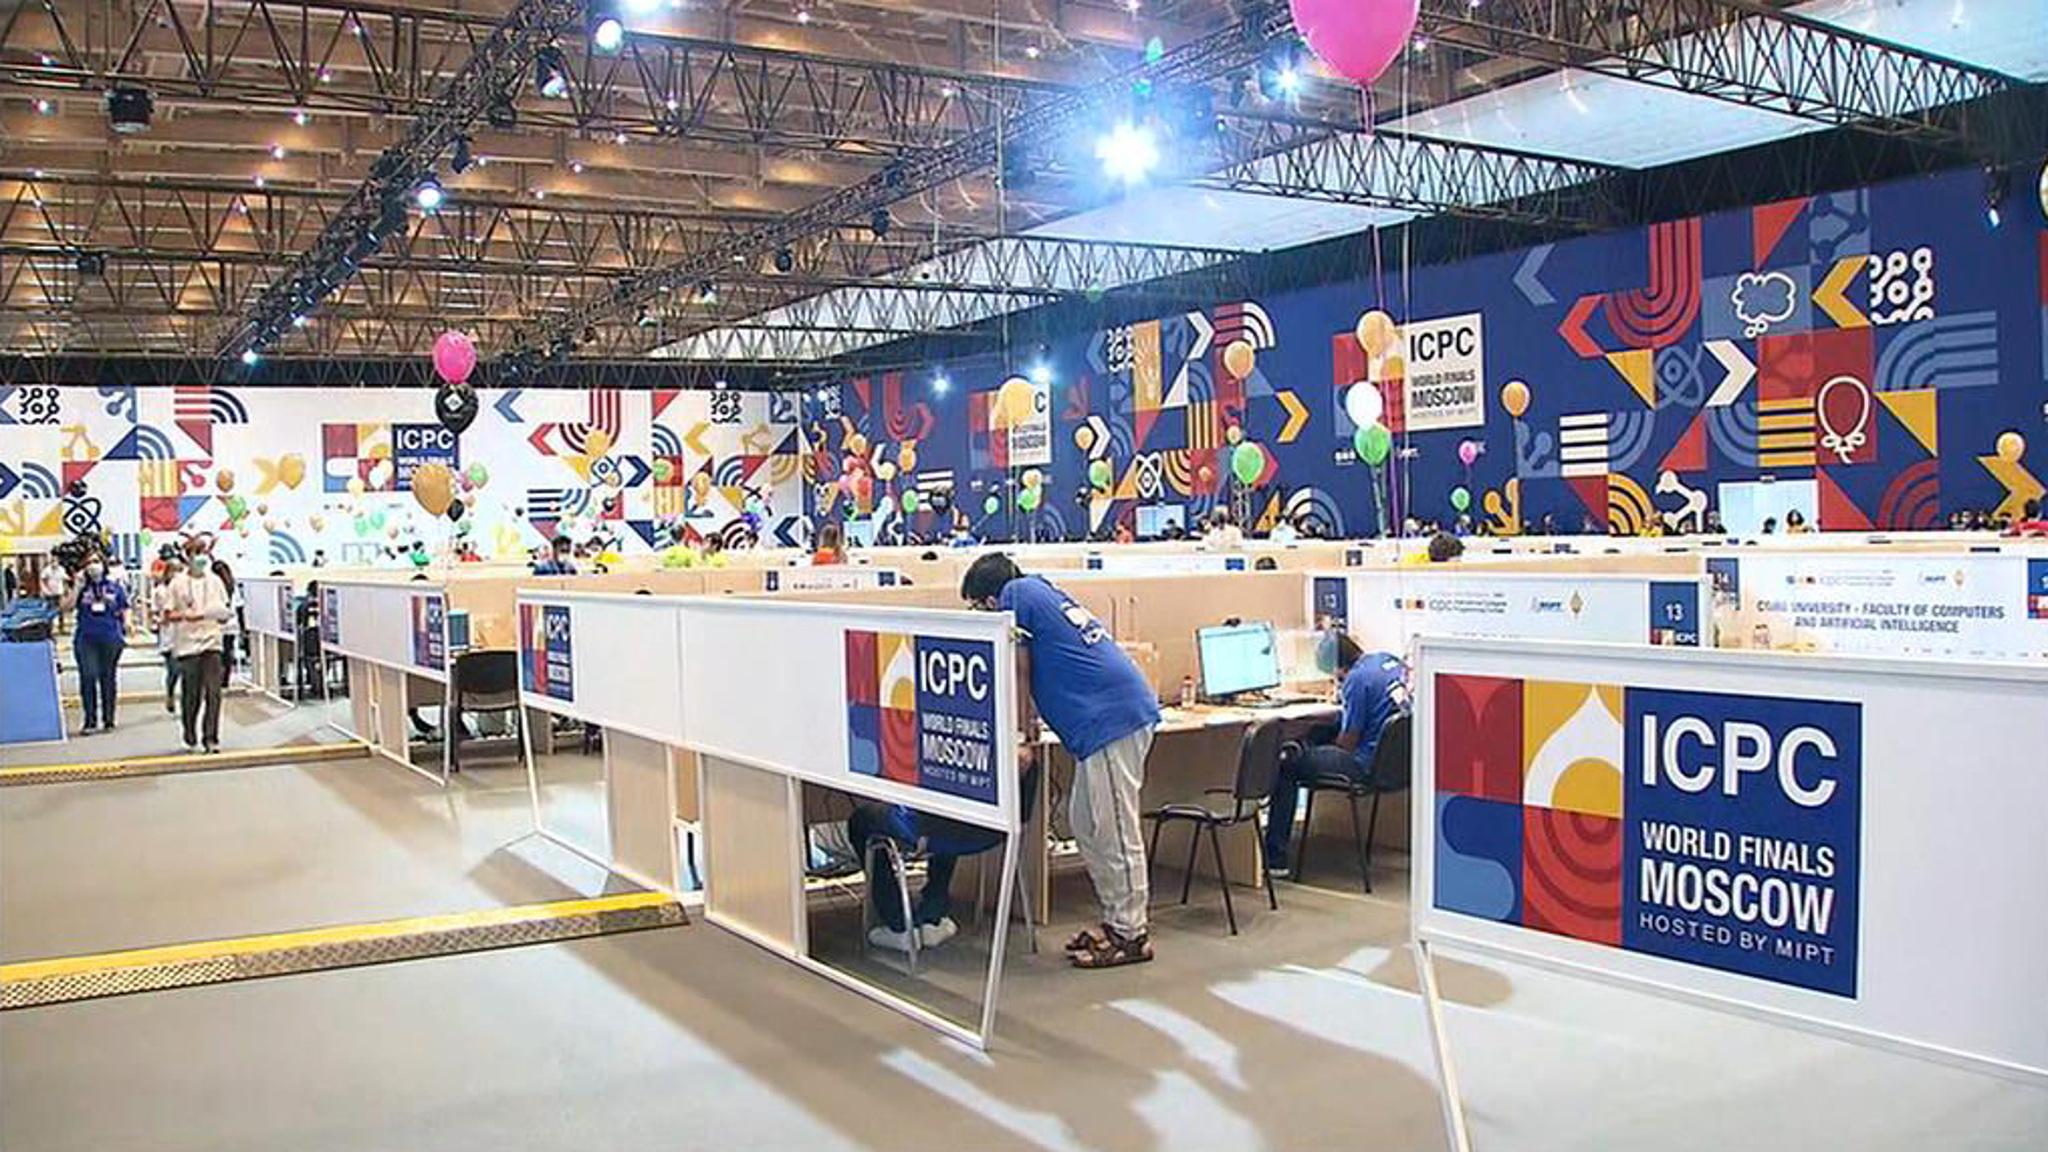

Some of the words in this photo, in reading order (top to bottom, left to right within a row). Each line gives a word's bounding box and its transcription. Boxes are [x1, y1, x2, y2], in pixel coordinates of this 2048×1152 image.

[1411, 327, 1474, 362] ICPC
[1411, 385, 1475, 408] MOSCOW
[397, 429, 454, 449] ICPC
[1665, 603, 1684, 621] 13
[1862, 603, 1911, 616] FACULTY
[1913, 604, 1929, 616] OF
[1931, 604, 2005, 619] COMPUTERS
[1880, 620, 1960, 633] INTELLIGENCE
[920, 650, 987, 700] ICPC
[922, 733, 990, 772] MOSCOW
[1643, 714, 1837, 807] ICPC
[1642, 821, 1730, 861] WORLD
[1739, 836, 1834, 877] FINALS
[1641, 858, 1834, 935] MOSCOW
[1640, 913, 1731, 943] HOSTED
[1740, 933, 1768, 950] BY
[1776, 939, 1835, 965] MIPT
